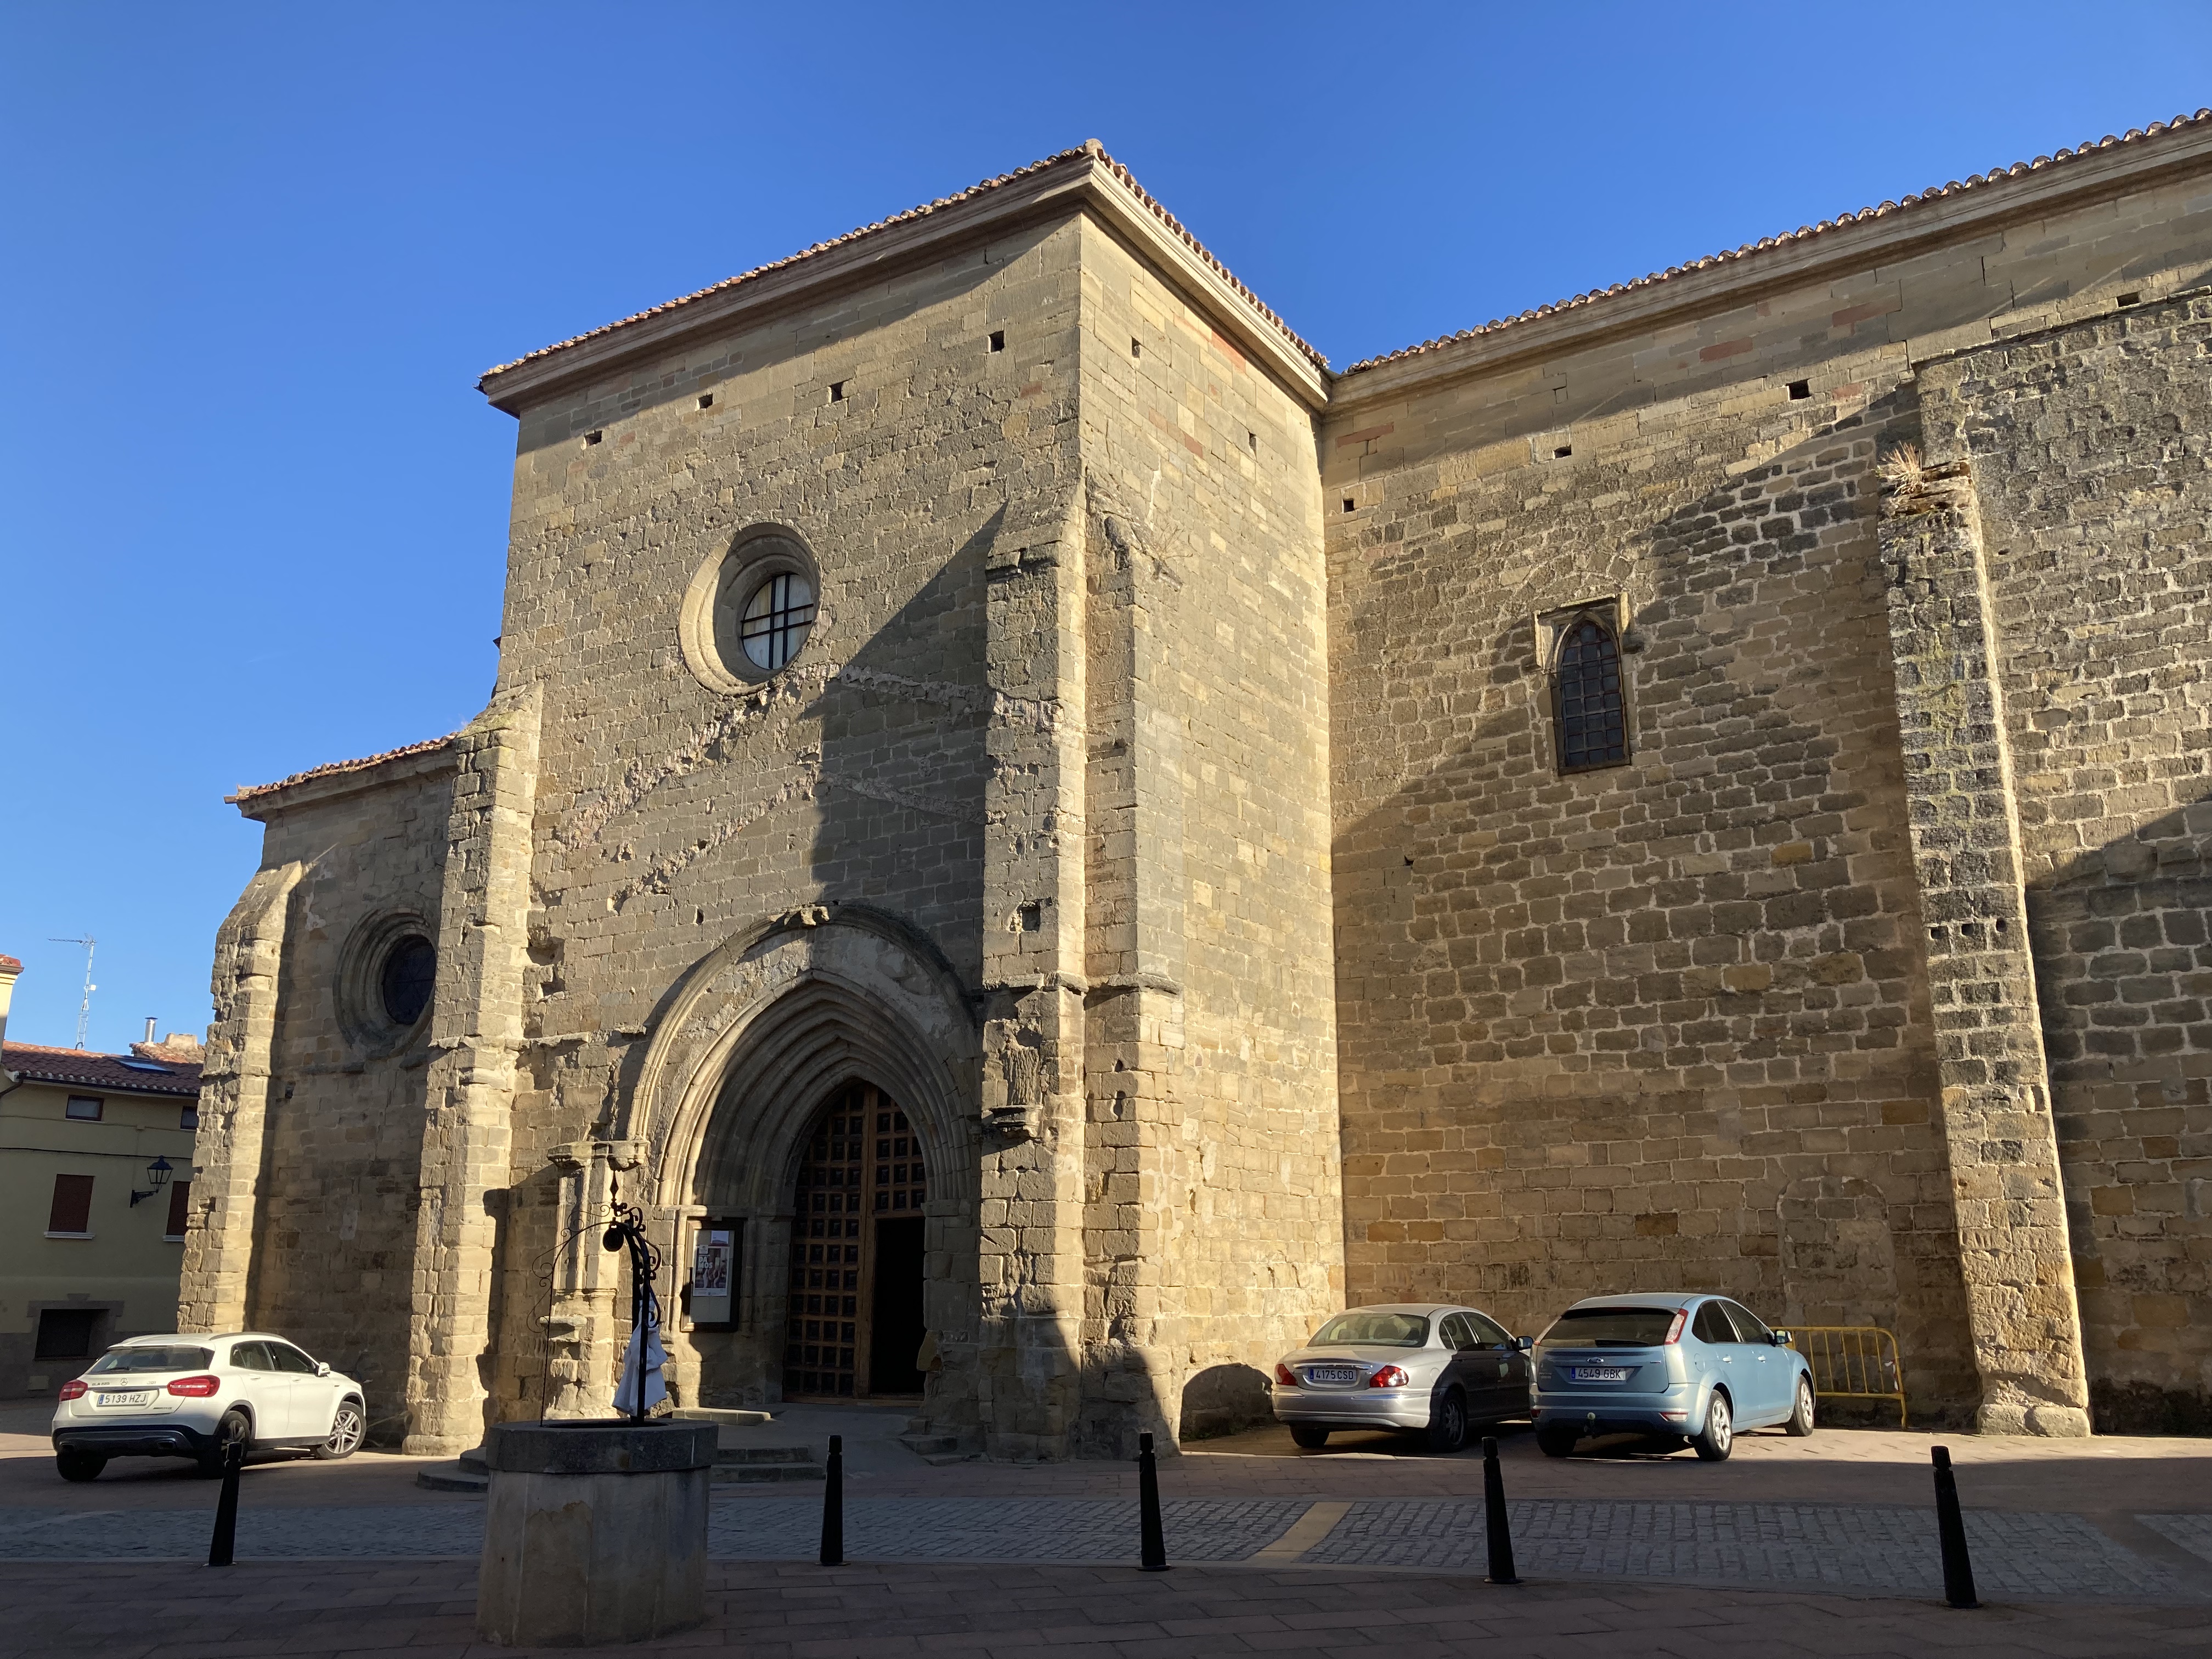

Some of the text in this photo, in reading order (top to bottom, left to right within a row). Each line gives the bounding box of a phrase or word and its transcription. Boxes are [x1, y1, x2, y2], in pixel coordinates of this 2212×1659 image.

[1316, 1370, 1354, 1380] 4175 CSD
[1578, 1369, 1621, 1379] 4549 GBK
[105, 1394, 146, 1403] 5139 HZJ
